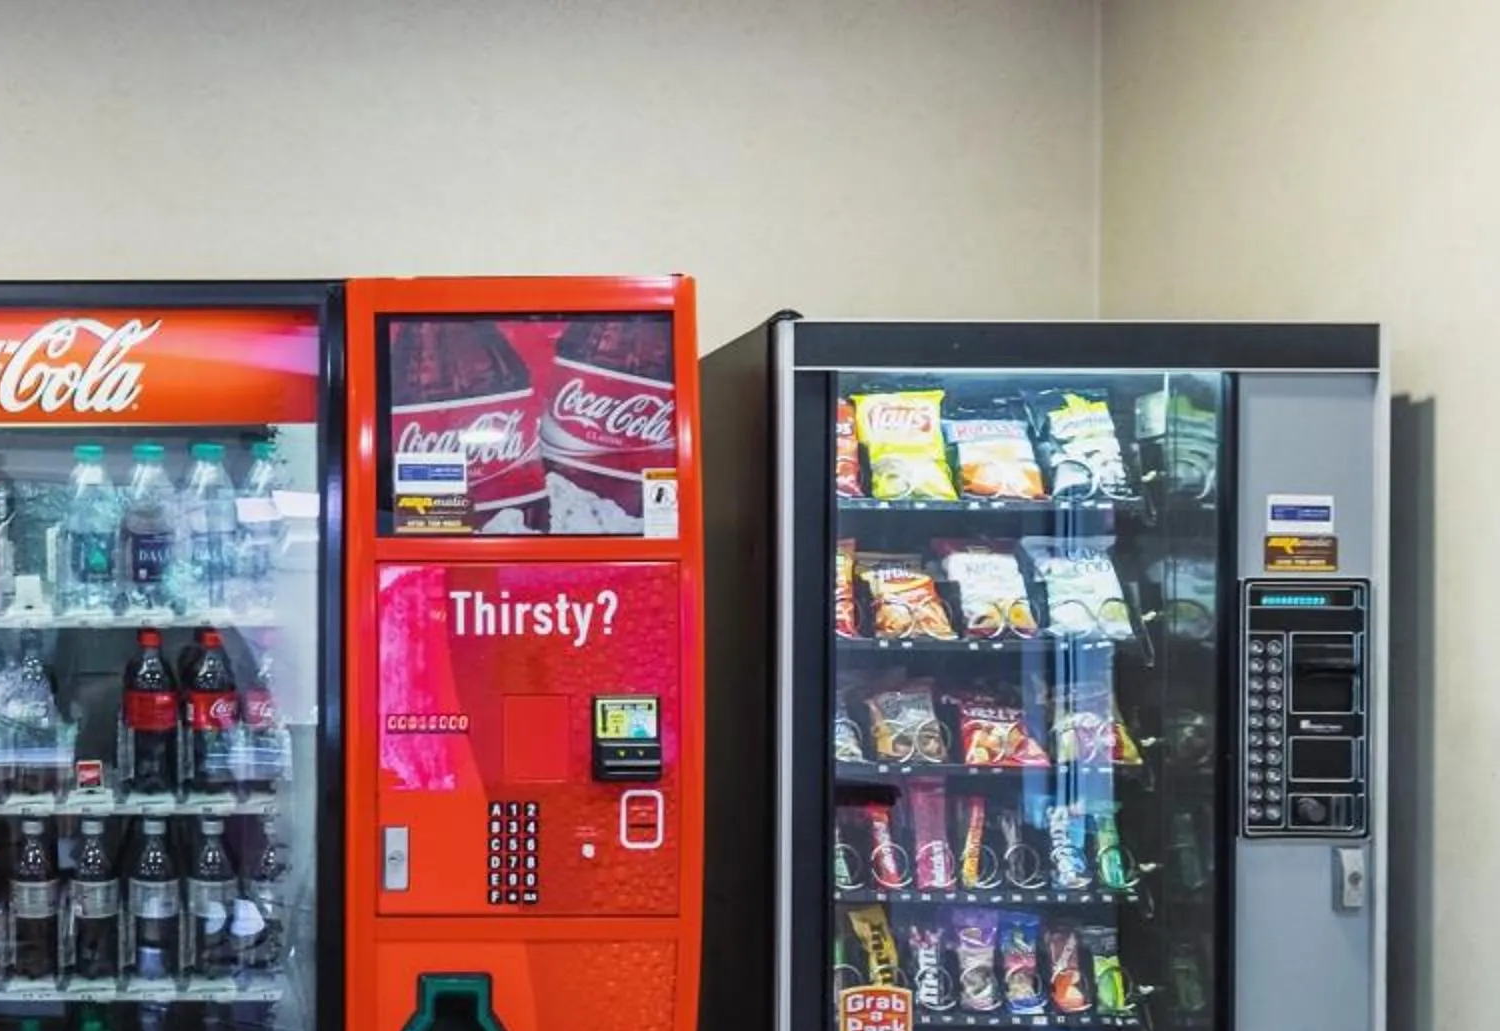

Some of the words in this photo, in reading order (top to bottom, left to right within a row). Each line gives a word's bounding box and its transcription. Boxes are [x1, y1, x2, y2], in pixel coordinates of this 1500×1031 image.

[553, 378, 676, 450] Coca-Cola
[449, 590, 619, 647] Thirsty?
[846, 993, 906, 1013] Grab
